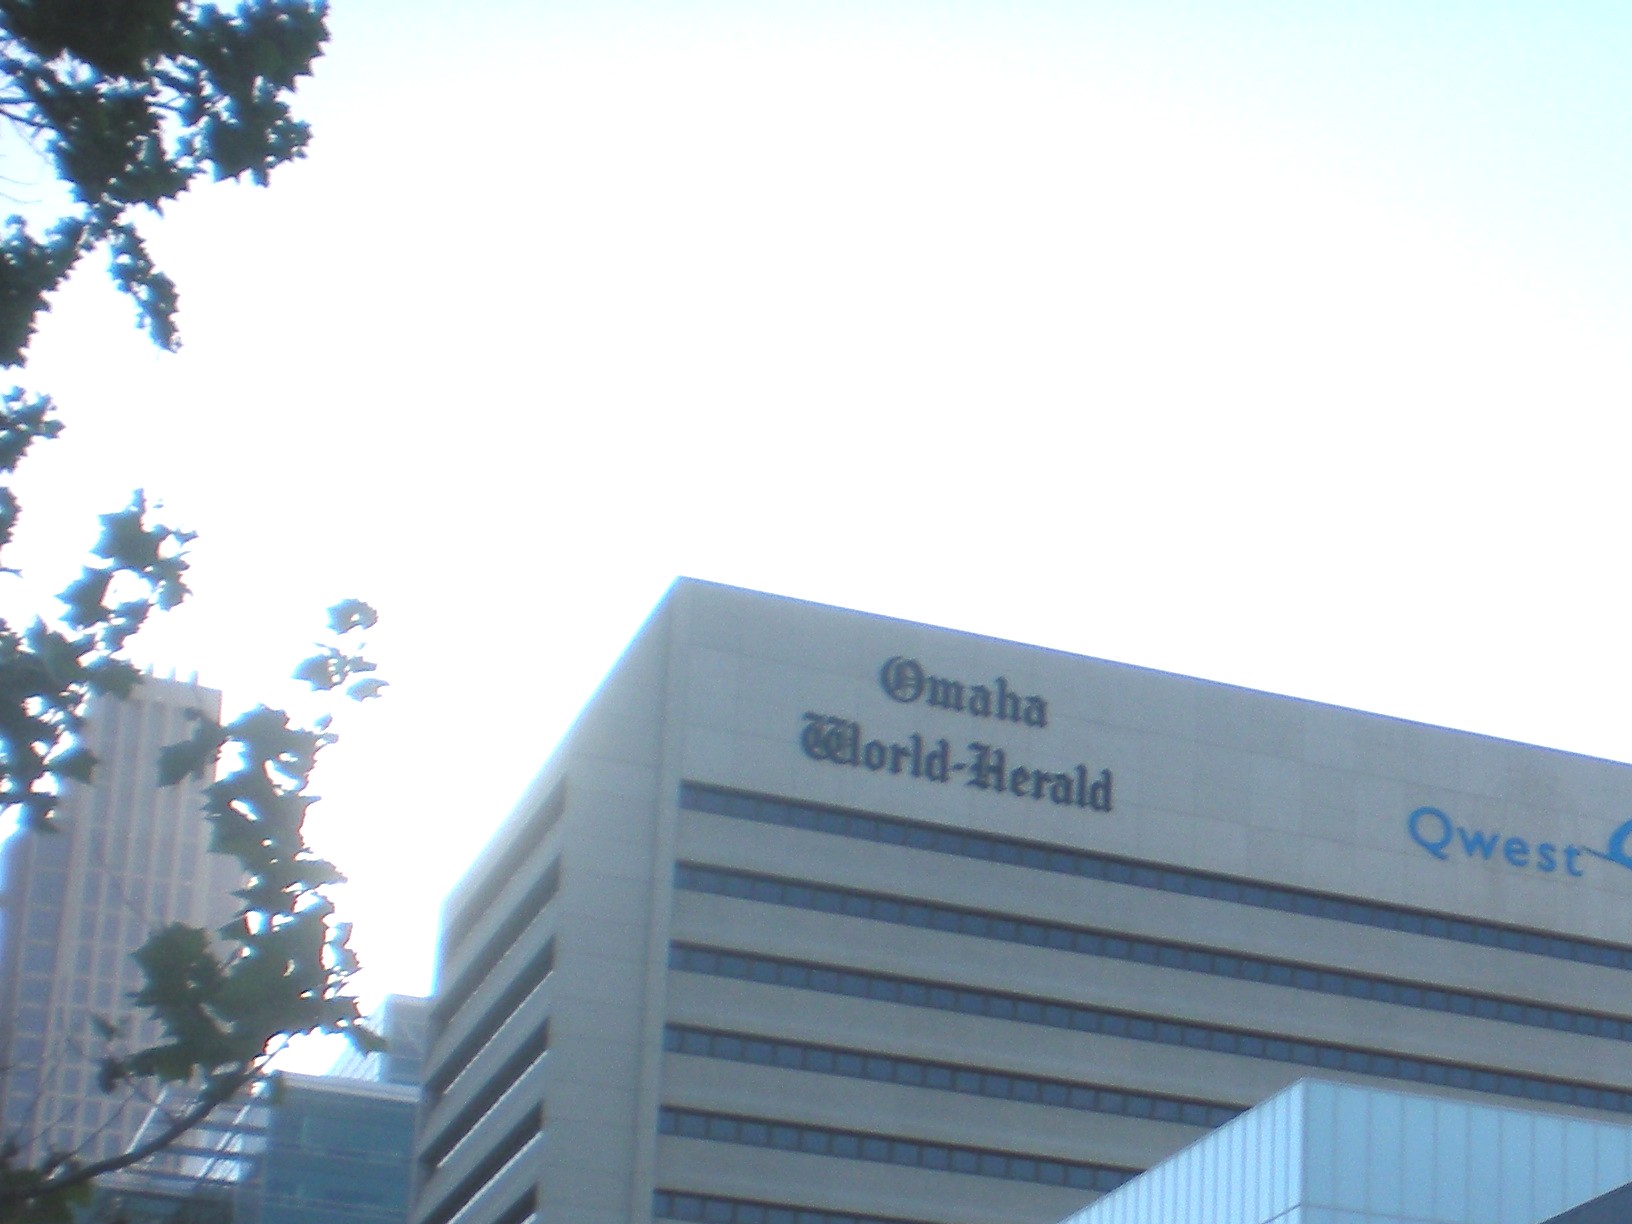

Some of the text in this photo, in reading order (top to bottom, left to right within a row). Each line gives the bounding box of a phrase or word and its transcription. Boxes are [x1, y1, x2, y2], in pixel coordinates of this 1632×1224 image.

[880, 655, 1048, 728] Omaha
[801, 710, 1113, 812] World-Herald
[1408, 806, 1584, 877] Qwest
